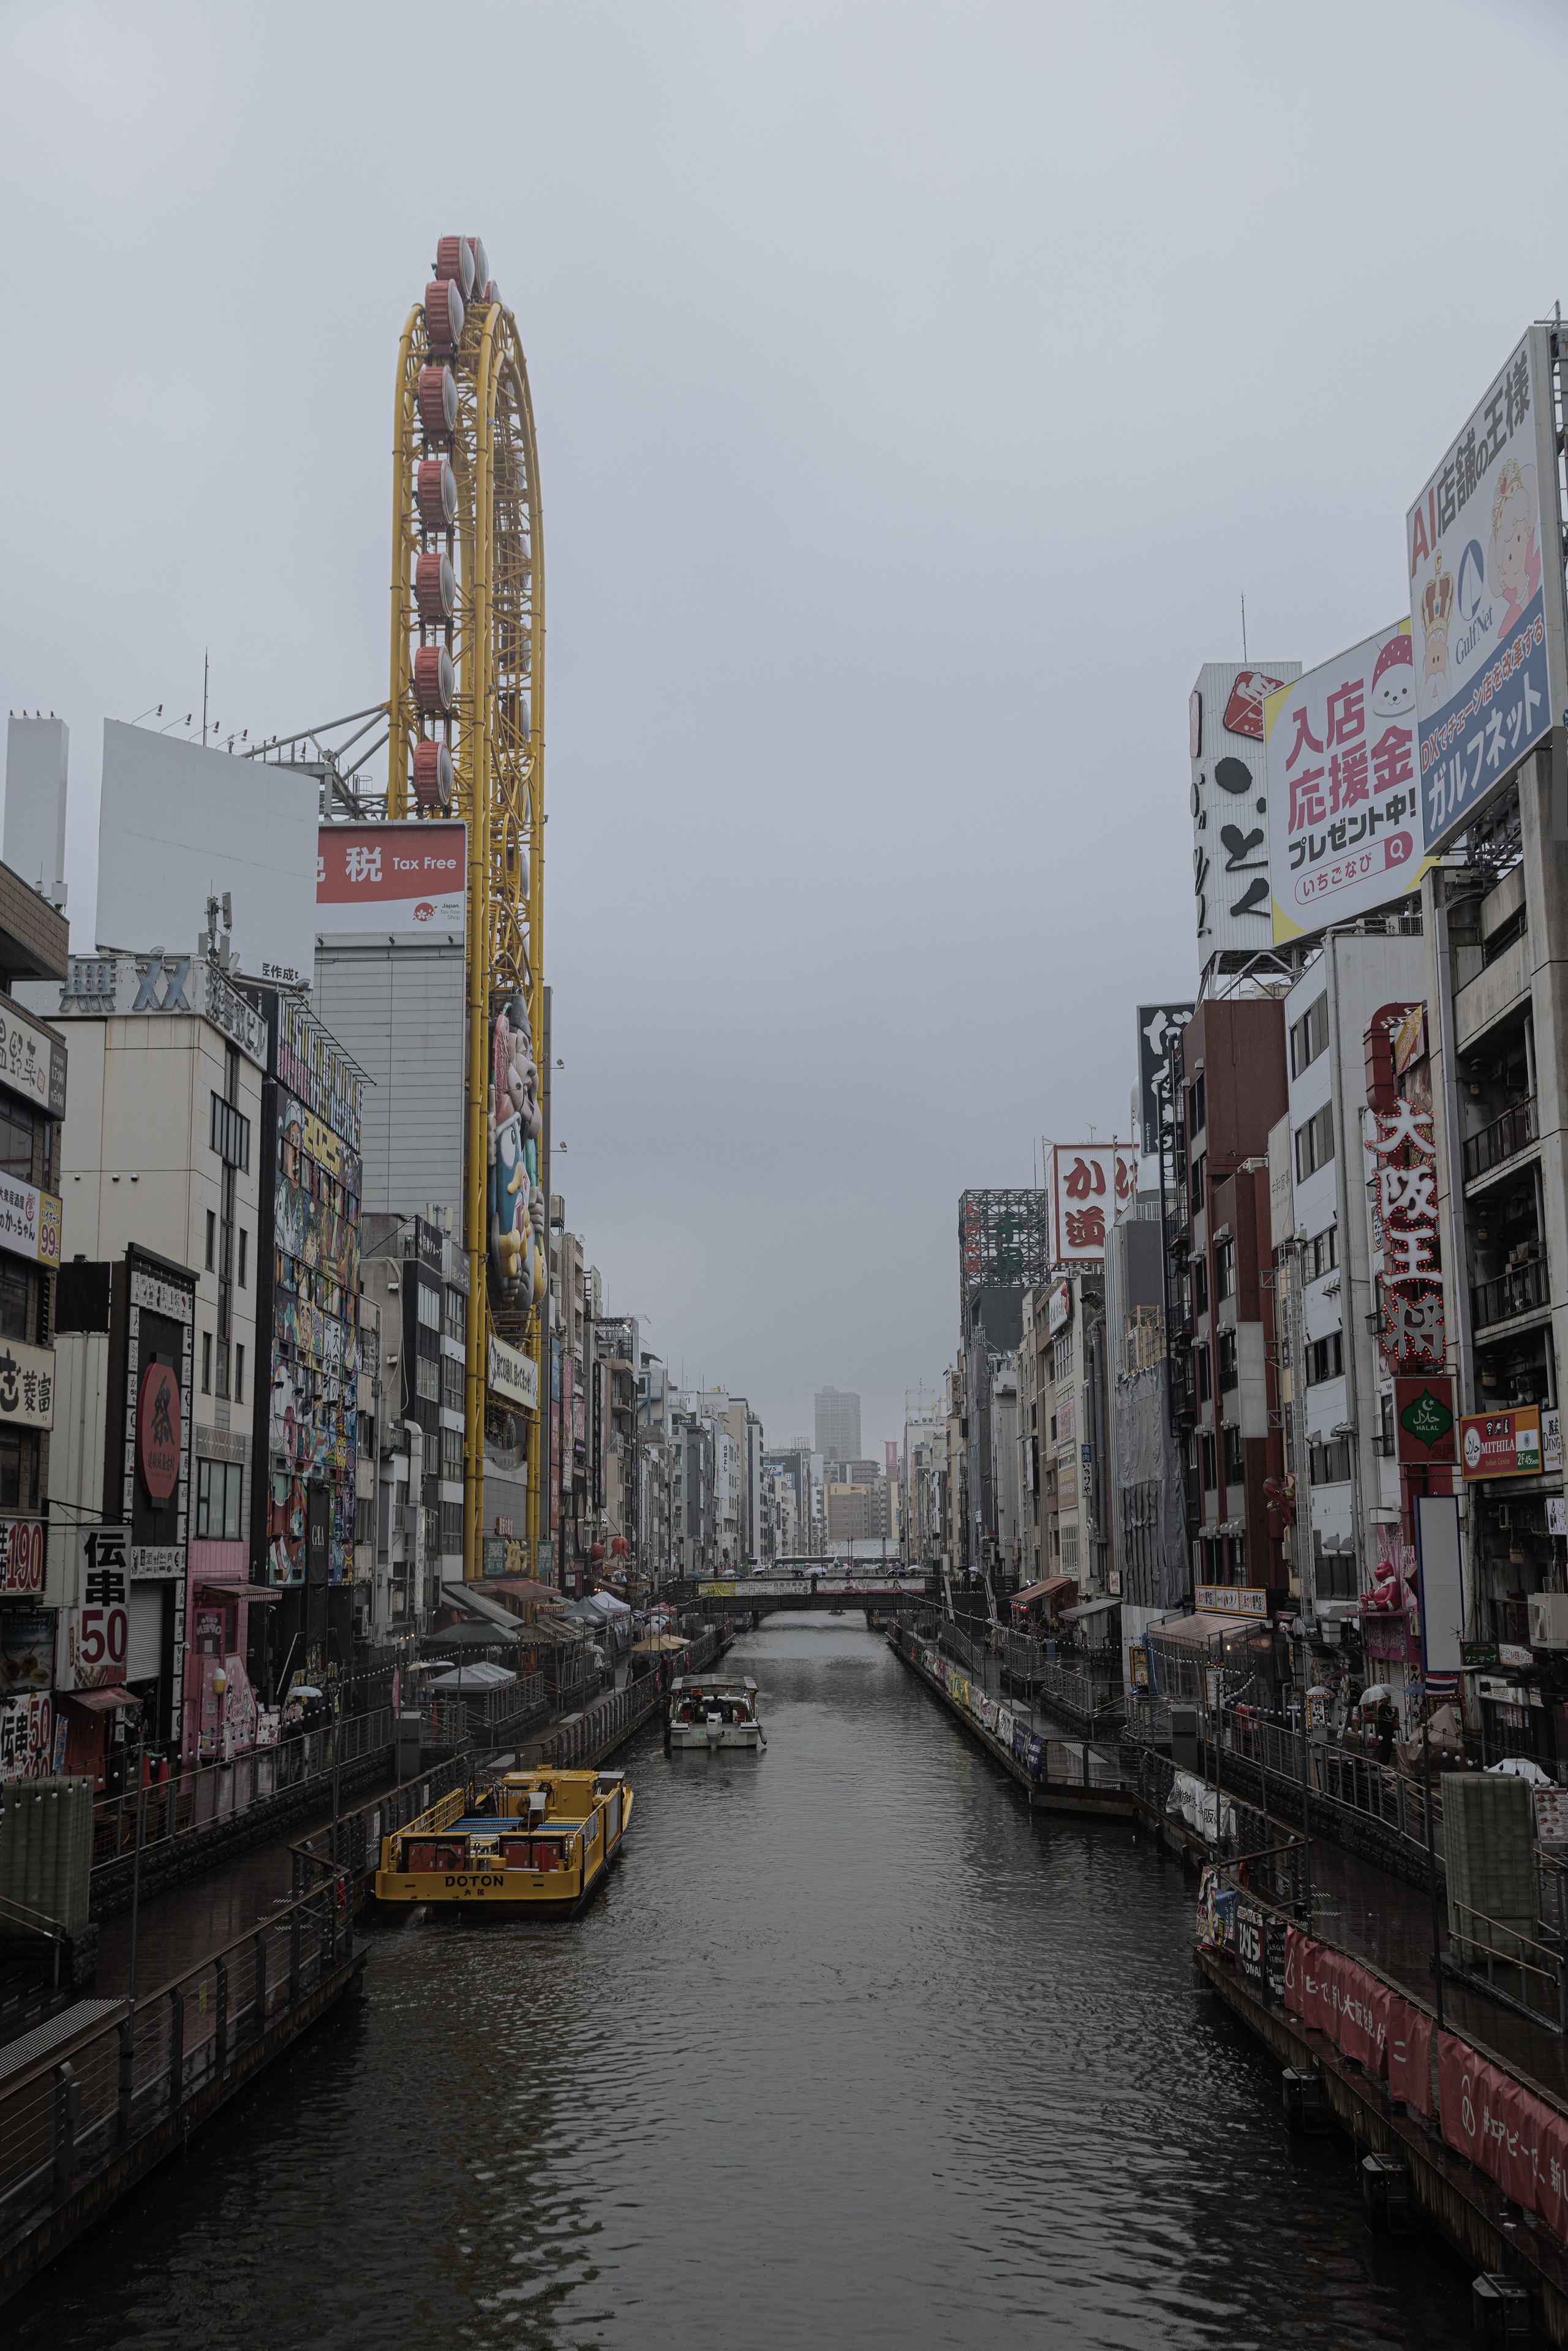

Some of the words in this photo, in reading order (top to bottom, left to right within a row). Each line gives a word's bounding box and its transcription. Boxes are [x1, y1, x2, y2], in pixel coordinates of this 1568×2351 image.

[1412, 350, 1530, 579] AI店舗の王様
[1421, 613, 1545, 775] DXでチェーン店を改革する
[1286, 677, 1365, 771] 入店
[1428, 671, 1541, 833] ガルフネット
[1288, 724, 1414, 836] 応援金
[393, 857, 419, 870] Tax
[424, 857, 457, 870] Free
[1302, 851, 1372, 897] いちごなび
[41, 1209, 61, 1226] ハイボール
[1366, 1100, 1446, 1362] 大阪王将
[41, 1224, 56, 1256] 99
[994, 1211, 1024, 1276] 千房
[1412, 1409, 1441, 1425] حلال
[1082, 1446, 1091, 1462] 焼肉
[1431, 1443, 1454, 1459] 2F
[1465, 1436, 1480, 1455] حلال
[1480, 1438, 1515, 1455] MITHILA
[1543, 1432, 1561, 1452] DING
[1517, 1453, 1525, 1465] 2F
[1082, 1463, 1091, 1496] いろりや
[7, 1523, 42, 1589] 190
[488, 1542, 503, 1558] 薬
[538, 1545, 552, 1558] 薬
[83, 1532, 127, 1607] 伝串
[81, 1609, 128, 1664] 50
[29, 1698, 50, 1754] 50
[445, 1874, 504, 1887] DOTON
